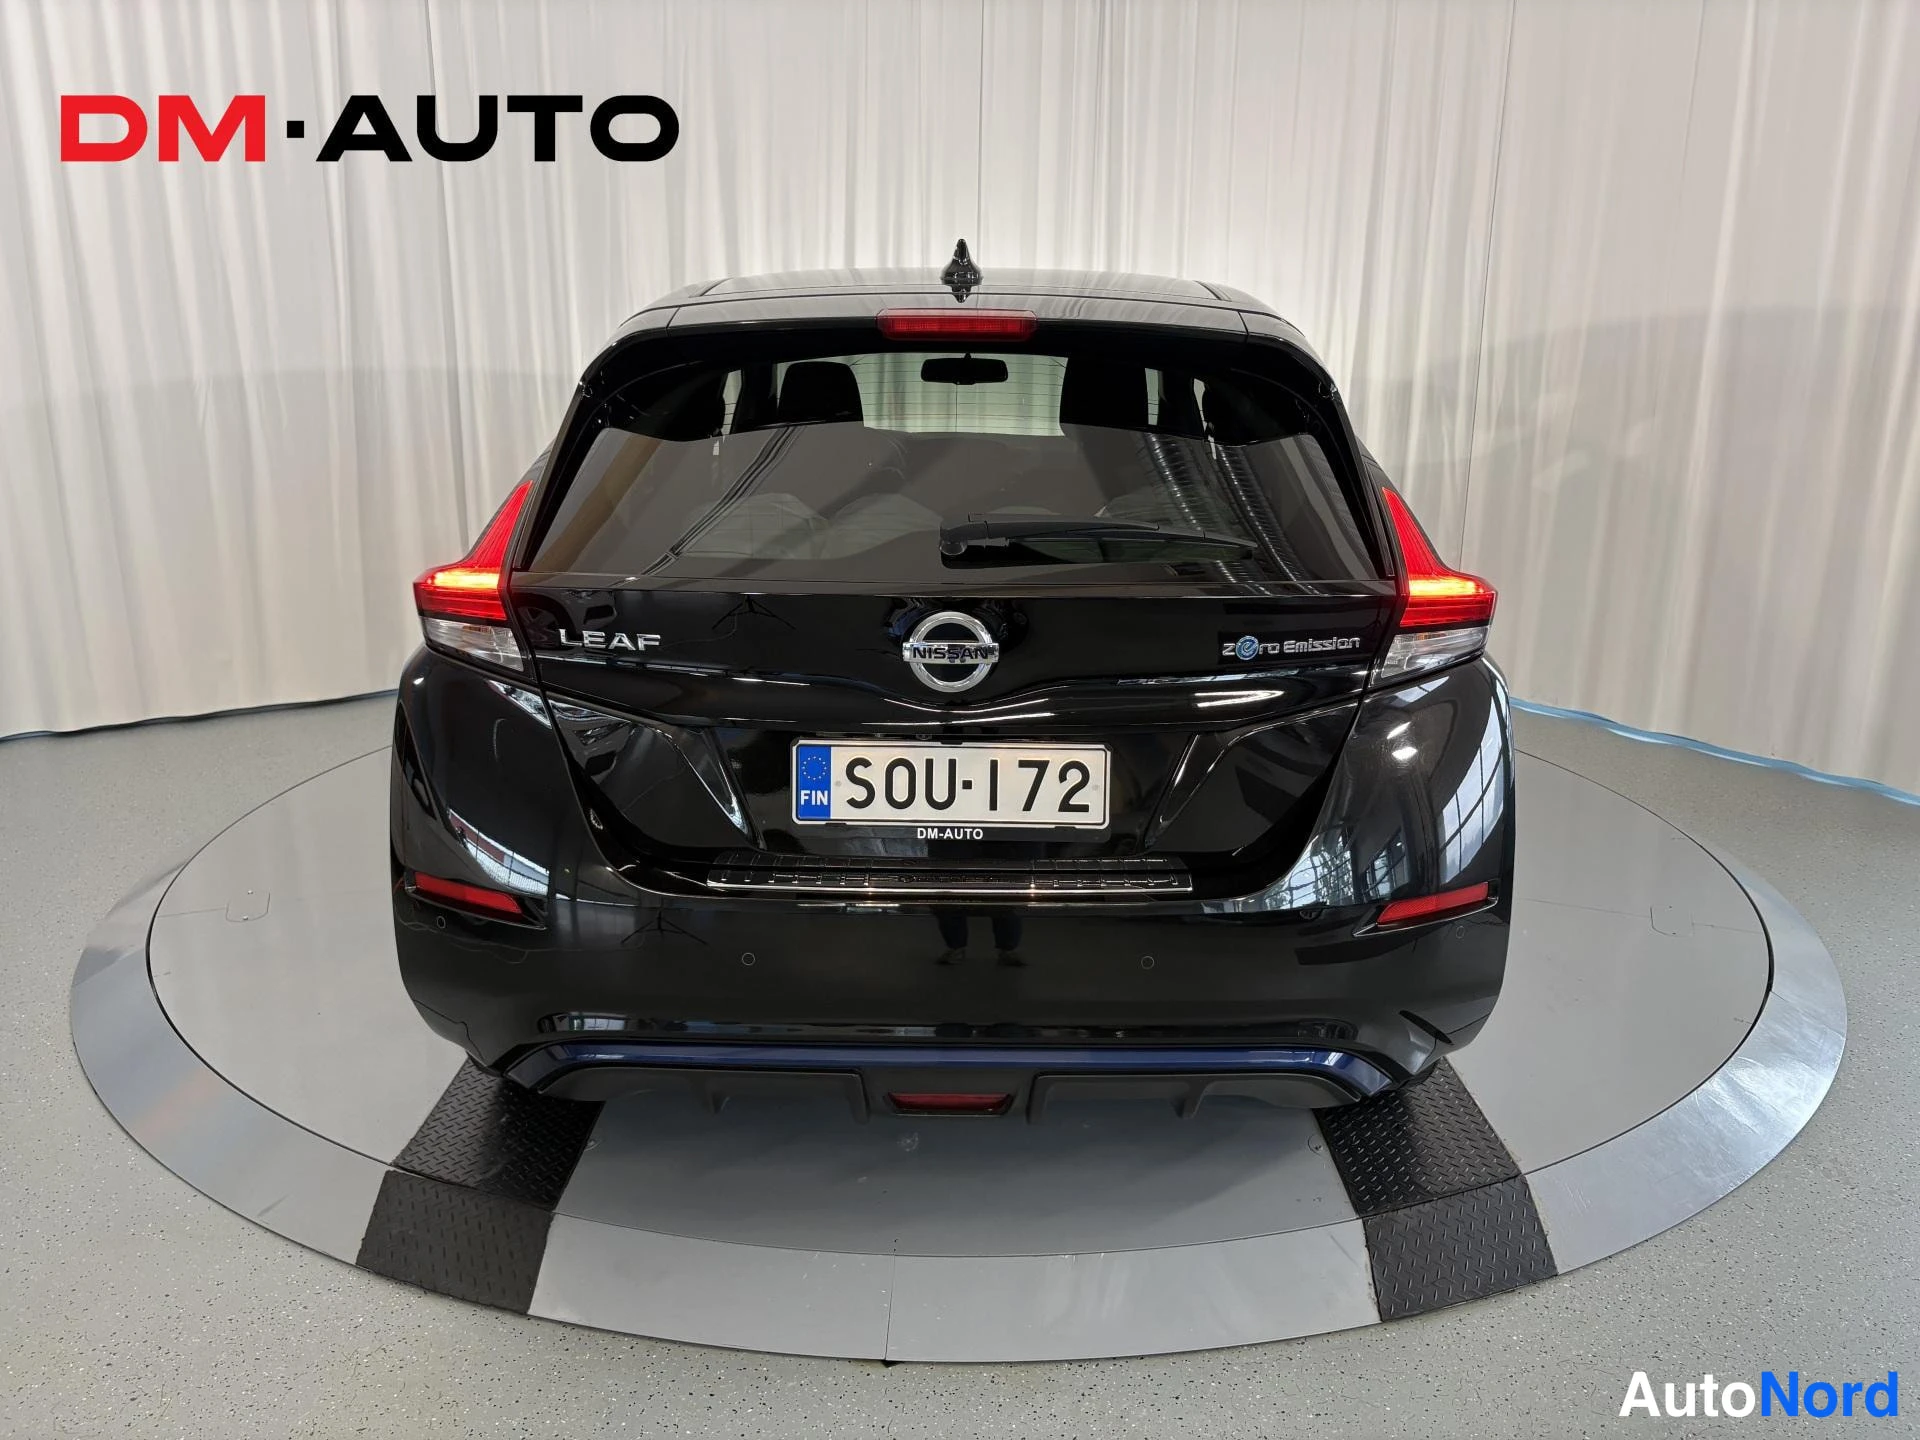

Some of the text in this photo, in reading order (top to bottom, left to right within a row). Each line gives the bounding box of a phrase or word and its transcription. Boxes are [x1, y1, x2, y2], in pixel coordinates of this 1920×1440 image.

[559, 628, 661, 651] LEAF
[1283, 637, 1361, 653] Emission
[913, 646, 989, 660] NISSAN
[845, 757, 1091, 813] SOU-172
[800, 789, 829, 806] FIN
[916, 827, 984, 840] DM-AUTO
